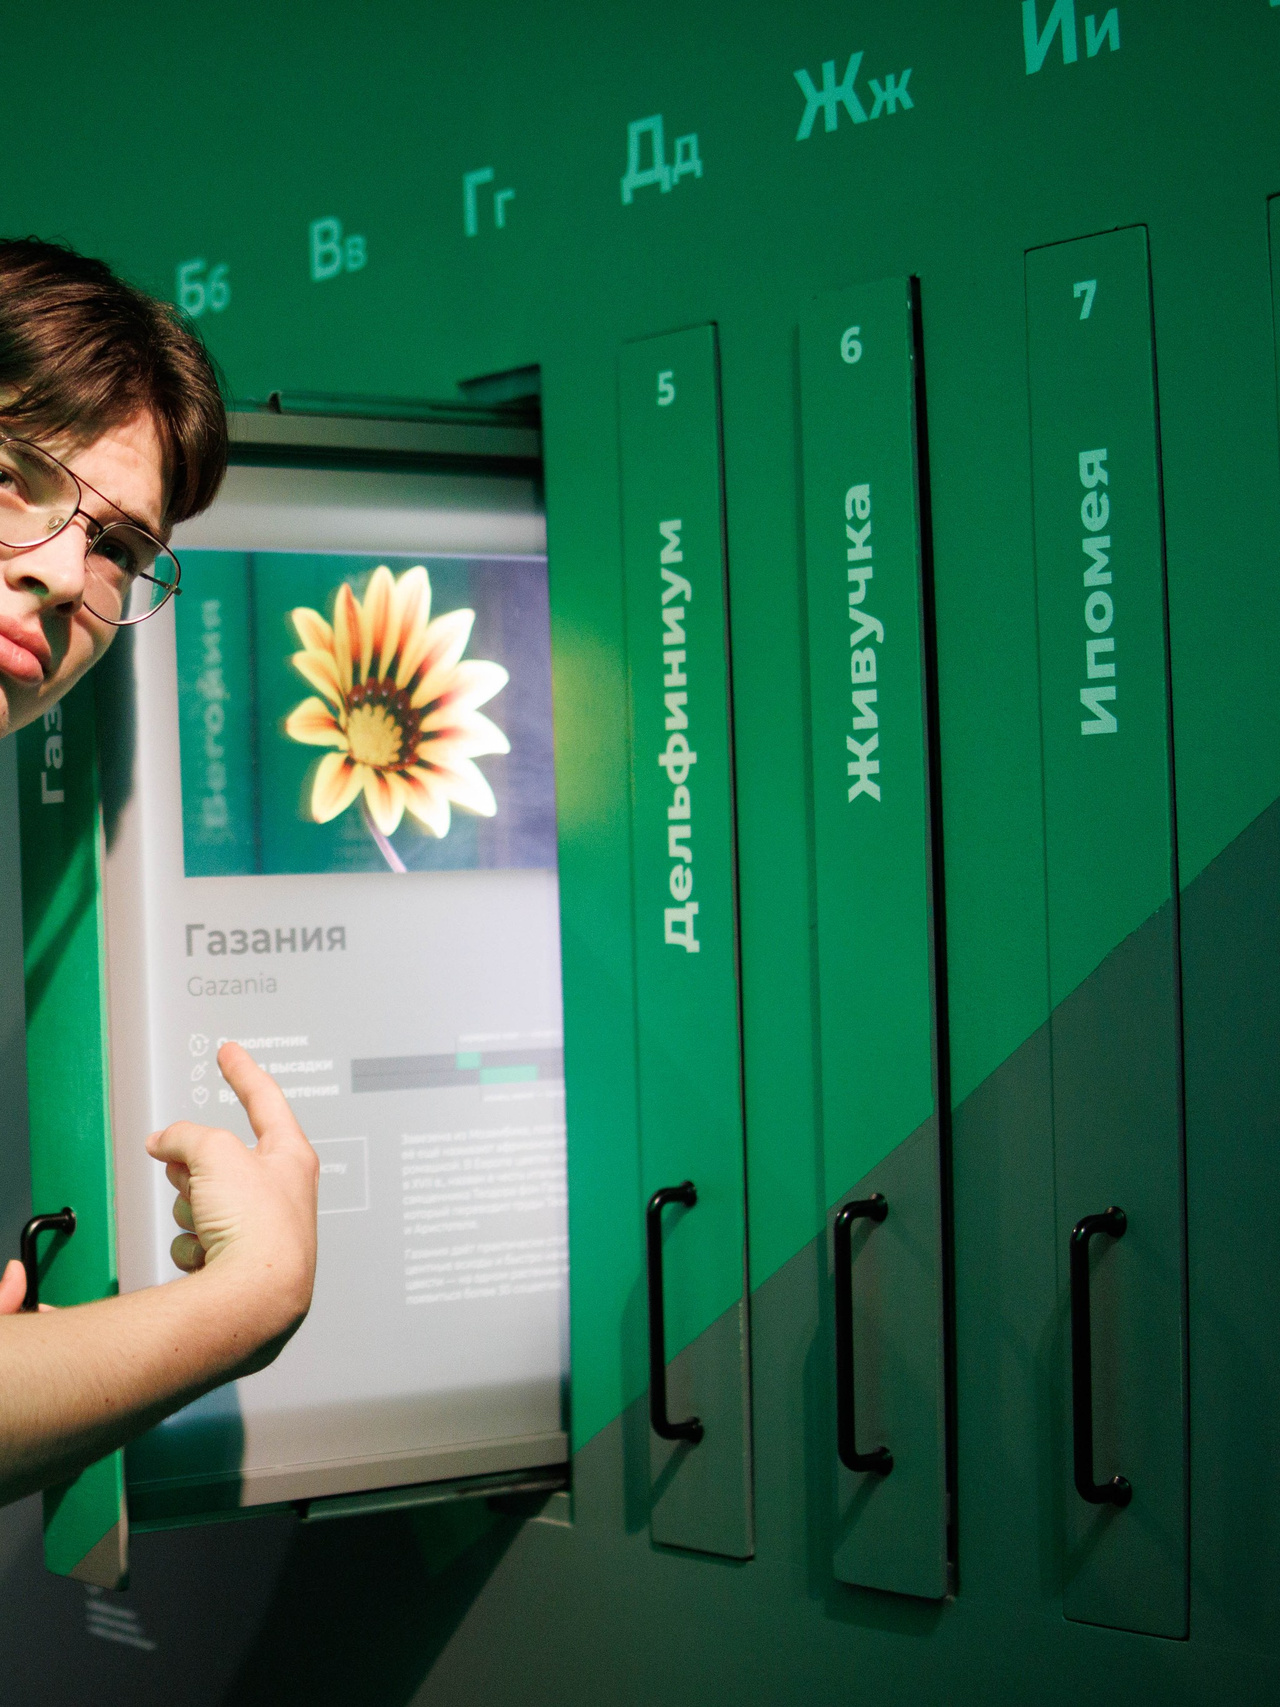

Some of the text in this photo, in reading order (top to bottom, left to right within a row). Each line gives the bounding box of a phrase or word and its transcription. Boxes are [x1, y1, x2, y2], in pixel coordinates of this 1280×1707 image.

[1021, 0, 1120, 75] Ии
[793, 50, 915, 142] Жж
[621, 113, 704, 205] Дд
[462, 166, 516, 237] Гг
[309, 215, 368, 281] Вв
[175, 257, 232, 318] Бб
[1072, 279, 1098, 320] 7
[839, 325, 863, 364] 6
[657, 370, 676, 405] 5
[1078, 447, 1119, 736] Ипомея
[844, 483, 885, 803] Живучка
[40, 700, 65, 804] Газ
[658, 518, 701, 954] Дельфиниум
[185, 922, 347, 957] Газания
[187, 972, 278, 997] Gazania
[216, 1035, 309, 1050] Онолетник
